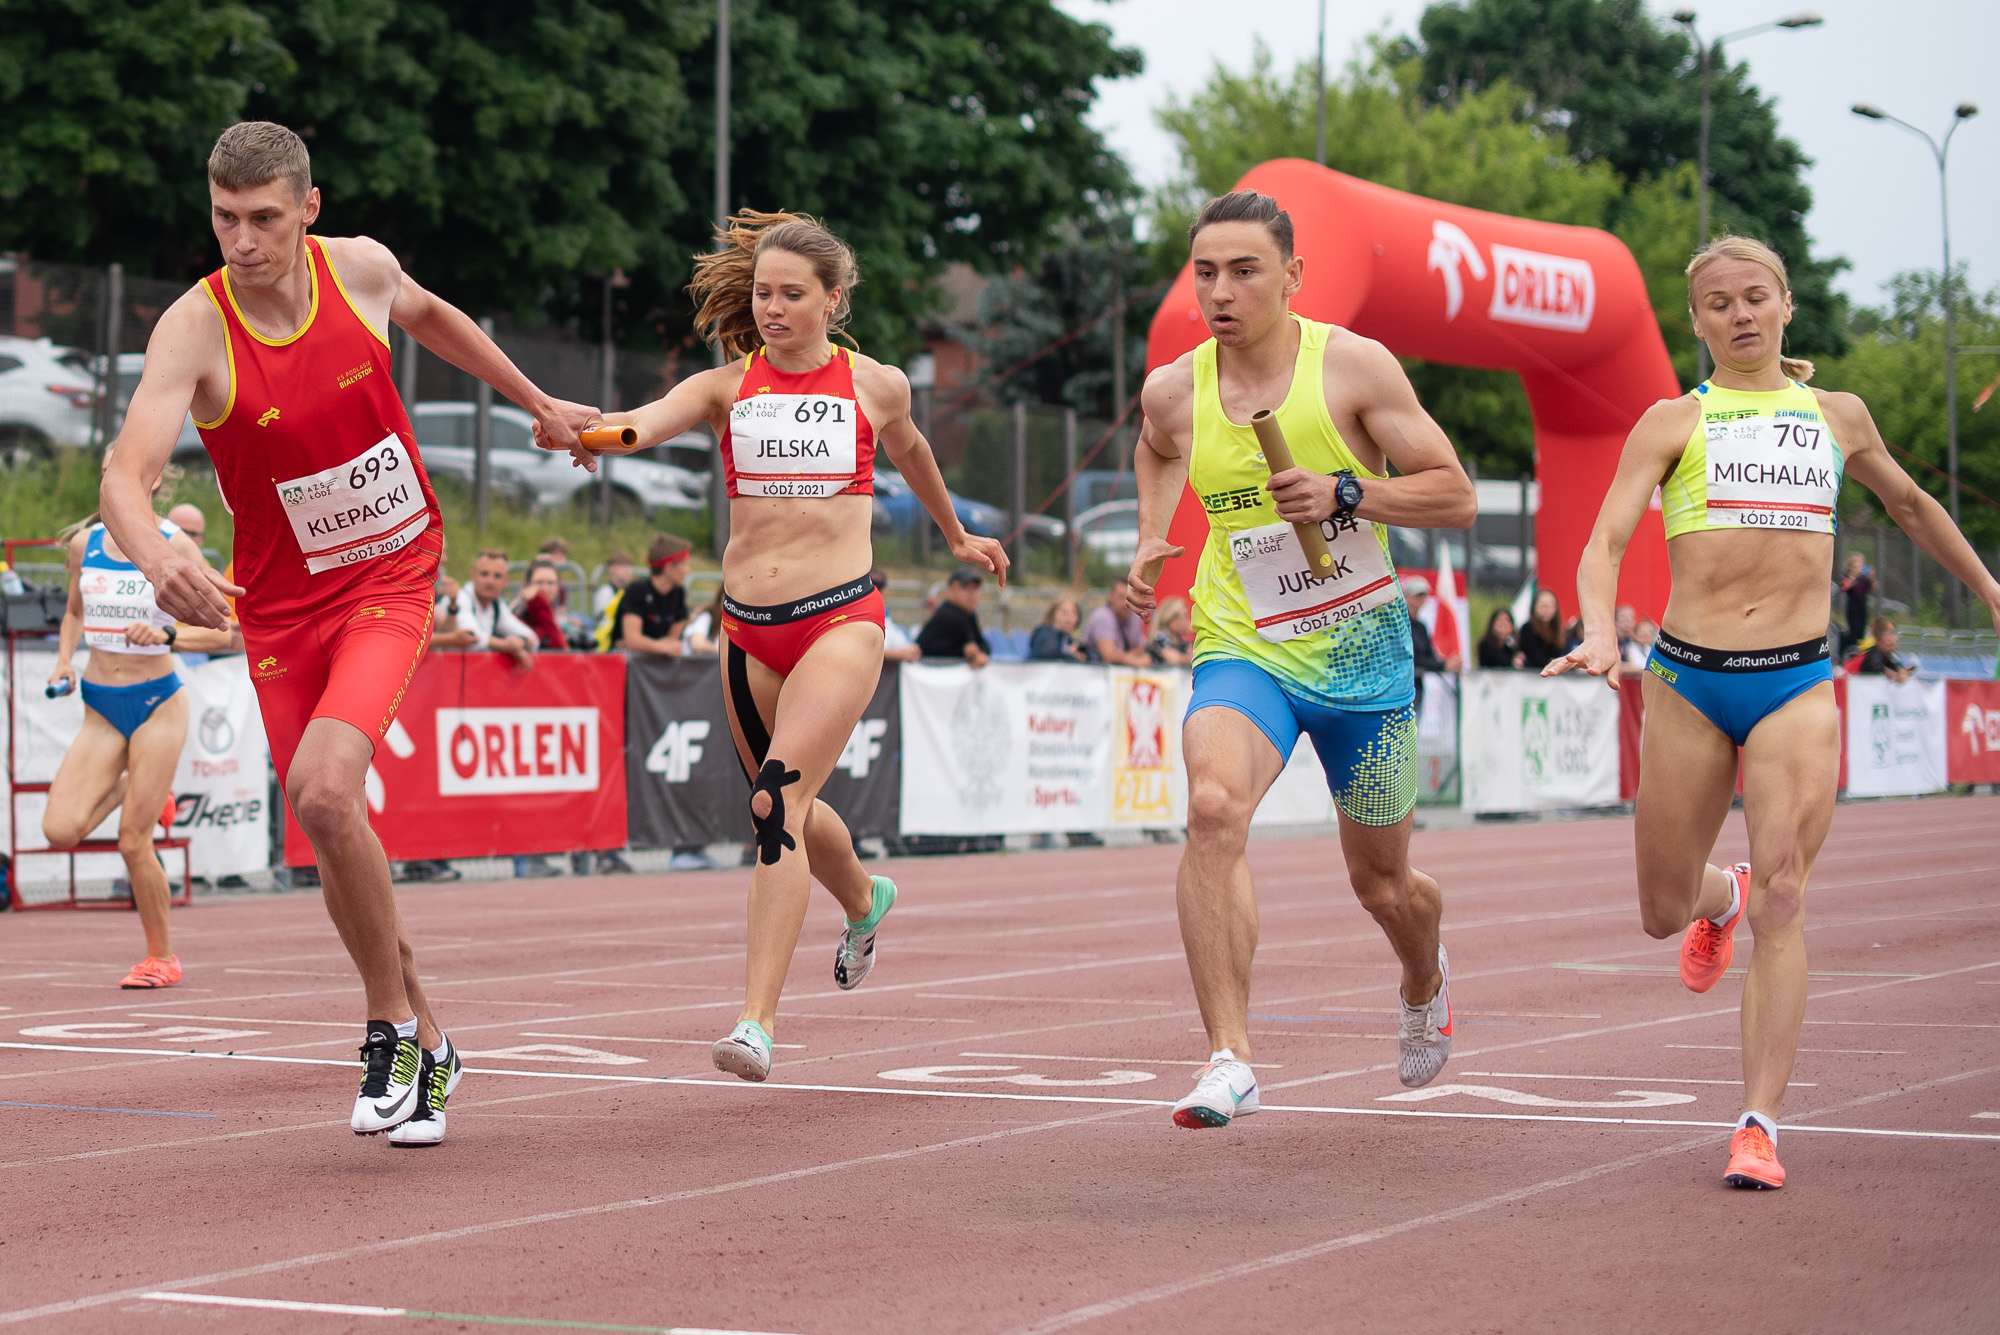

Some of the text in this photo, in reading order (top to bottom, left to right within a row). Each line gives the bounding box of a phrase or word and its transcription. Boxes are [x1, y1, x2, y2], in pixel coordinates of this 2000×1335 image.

[1503, 262, 1586, 315] ORLEN
[338, 366, 374, 389] BIAŁYSTOK
[345, 360, 372, 377] PODLASIE
[794, 401, 846, 423] 691
[757, 439, 830, 458] JELSKA
[1773, 424, 1820, 450] 707
[348, 447, 399, 490] 693
[1714, 463, 1832, 489] MICHALAK
[307, 482, 325, 493] AZS
[309, 487, 333, 500] ŁÓDŹ
[762, 481, 824, 495] ŁÓDŹ 2021
[307, 484, 410, 537] KLEPACKI
[1739, 509, 1808, 528] ŁÓDŹ 2021
[1319, 515, 1359, 542] 04
[340, 543, 376, 564] ŁÓDŹ
[377, 534, 407, 554] 2021
[1256, 535, 1275, 546] AZS
[1259, 540, 1282, 555] ŁÓDŹ
[116, 579, 147, 595] 287
[723, 599, 772, 621] AdRunaLine
[791, 584, 864, 617] AdRunaLine
[1292, 612, 1331, 634] ŁÓDŹ
[1332, 602, 1364, 623] 2021
[93, 633, 114, 644] ŁÓDŹ
[1656, 634, 1702, 663] RunaLine
[1722, 651, 1801, 667] AdRunaLine
[378, 715, 390, 736] KS
[449, 722, 588, 780] ORLEN
[646, 719, 711, 784] 4F
[836, 718, 888, 780] 4F
[1114, 774, 1170, 812] PZLA
[19, 1022, 273, 1042] 5
[457, 1043, 649, 1066] 4
[876, 1065, 1158, 1087] 3
[1373, 1083, 1698, 1108] 2
